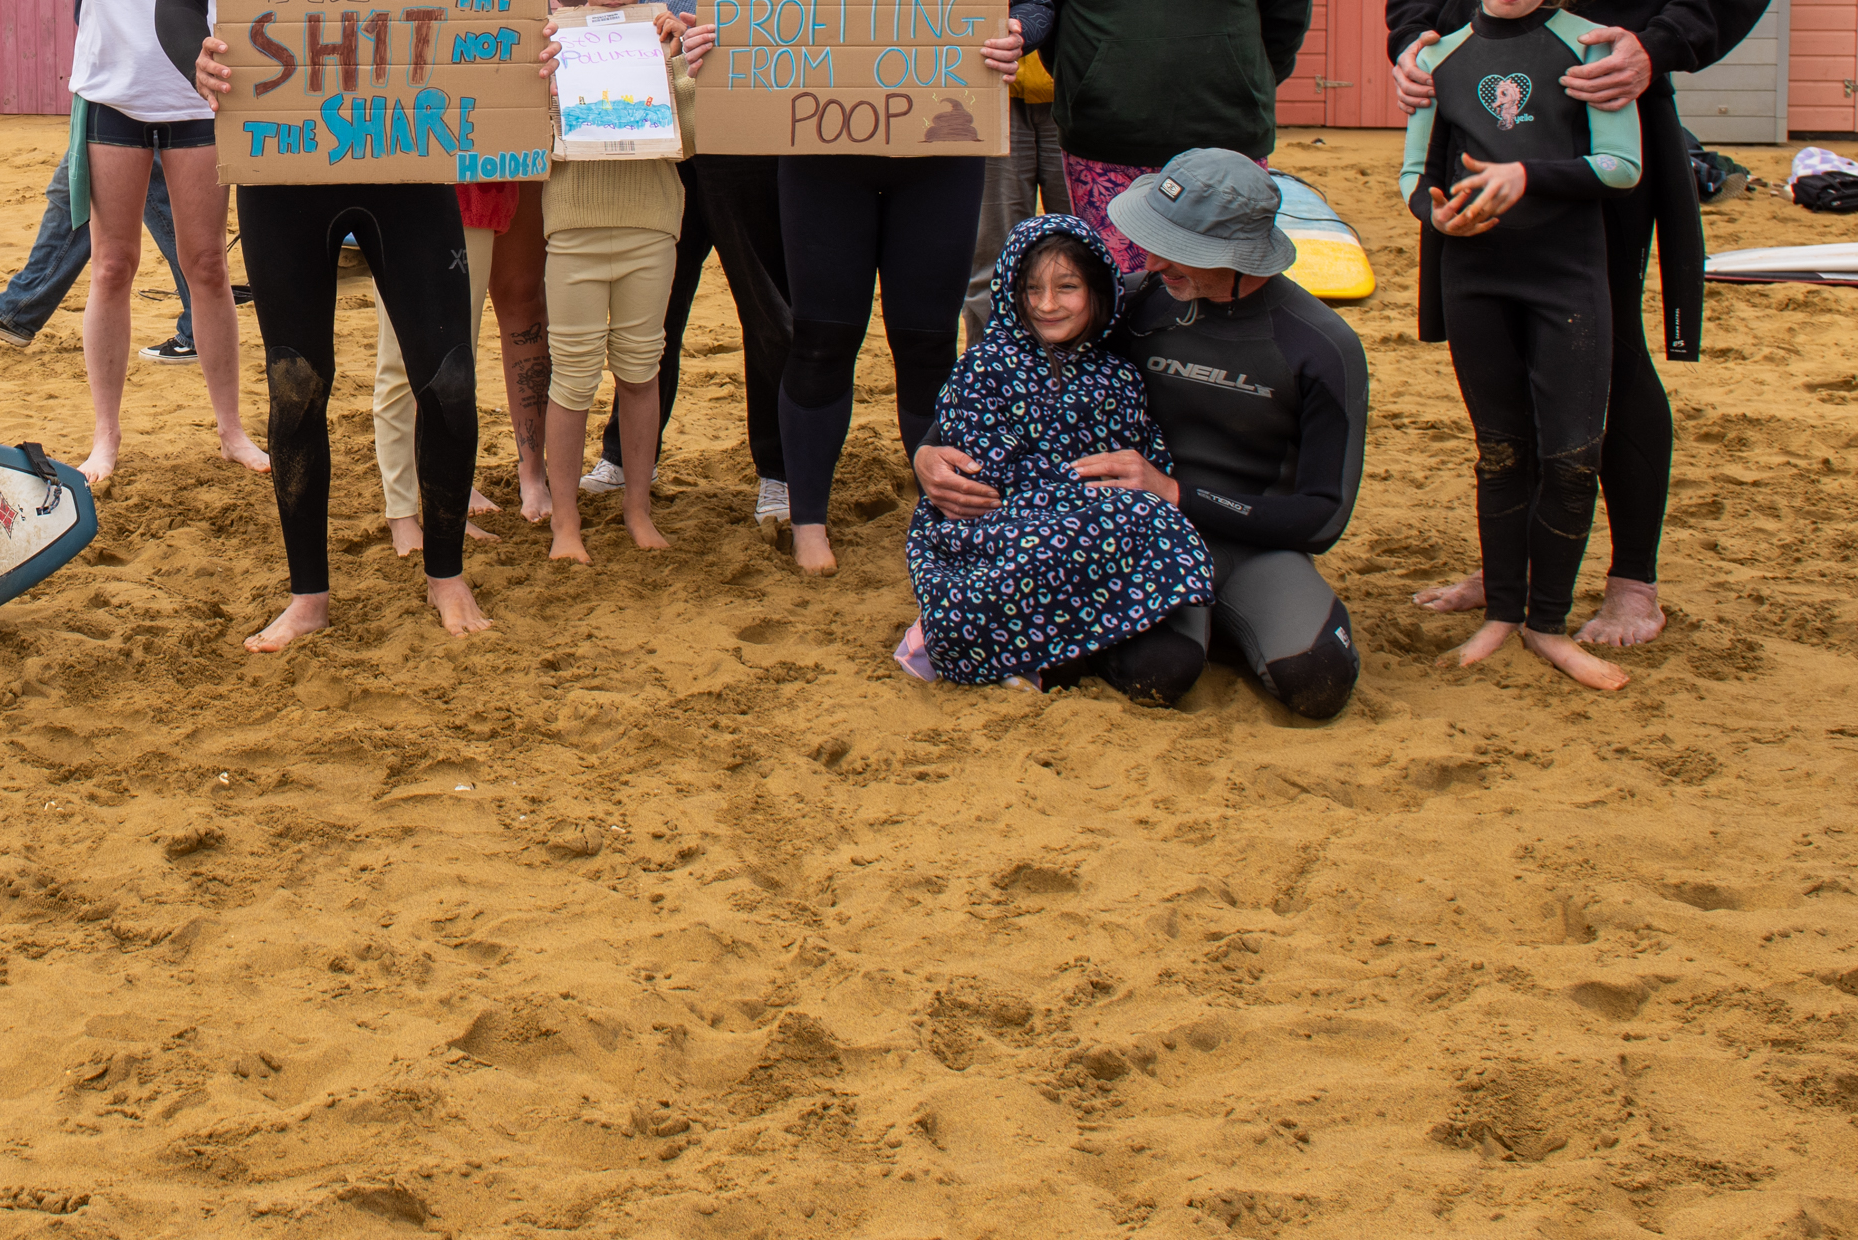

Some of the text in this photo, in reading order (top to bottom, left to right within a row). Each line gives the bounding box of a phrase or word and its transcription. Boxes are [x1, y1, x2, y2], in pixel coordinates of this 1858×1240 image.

[452, 27, 520, 64] NOT
[728, 46, 969, 93] FROM OUR
[243, 120, 318, 157] THE
[321, 87, 476, 166] SHARE
[791, 91, 913, 147] POOP
[1147, 356, 1257, 391] O'NEILL
